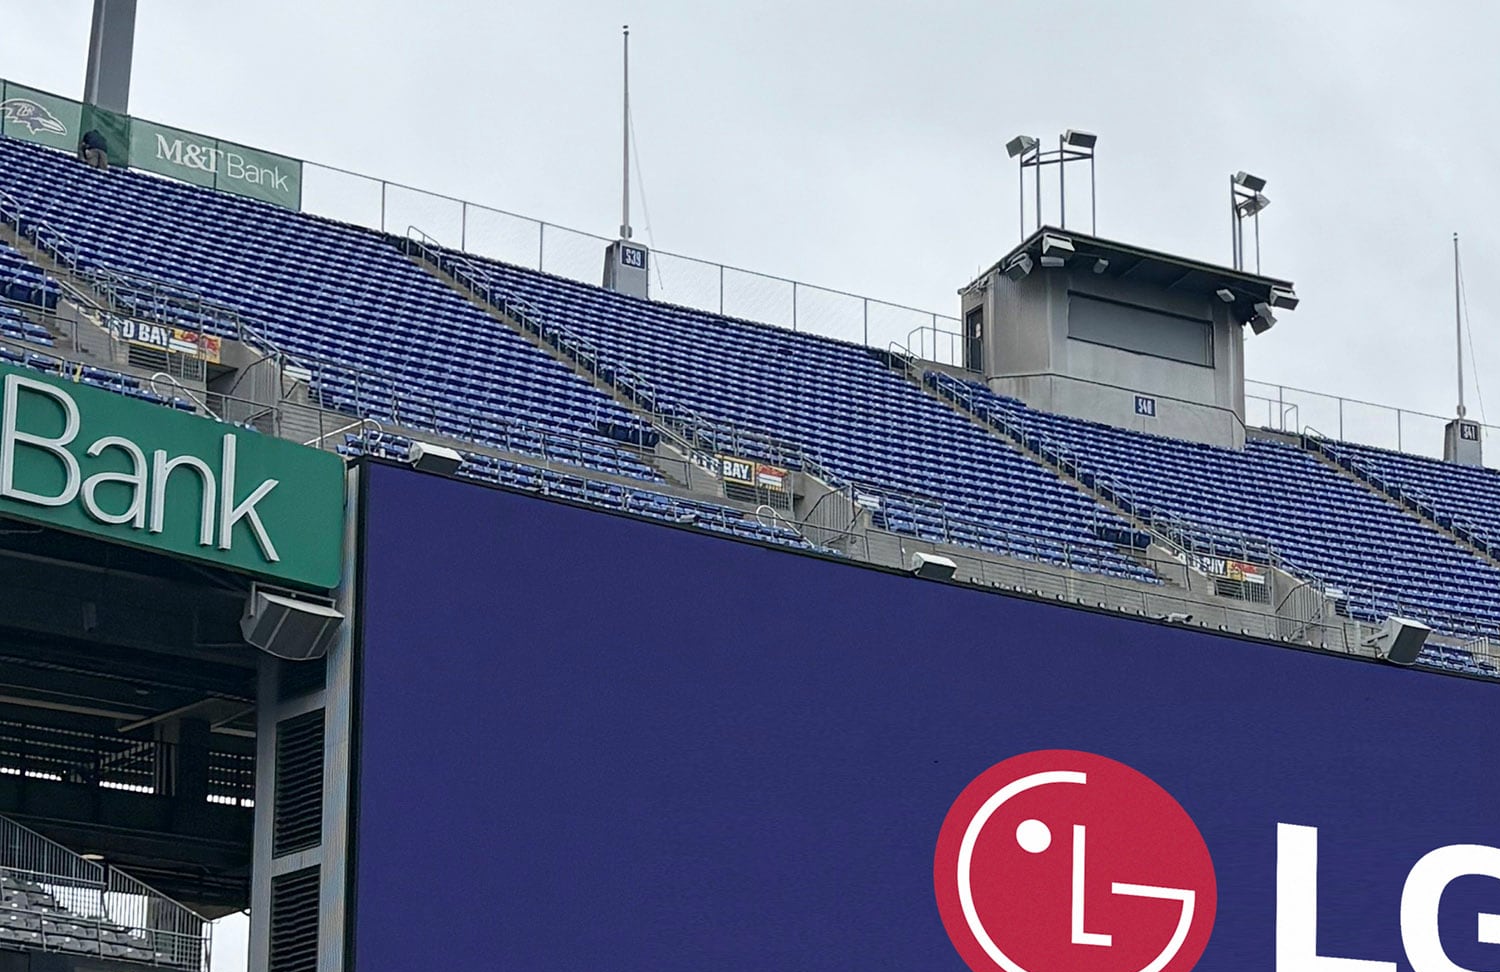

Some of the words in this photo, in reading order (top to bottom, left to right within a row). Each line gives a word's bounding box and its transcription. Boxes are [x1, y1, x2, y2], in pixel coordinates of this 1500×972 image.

[155, 134, 223, 173] M&T
[227, 152, 289, 192] Bank
[0, 374, 280, 562] Bank
